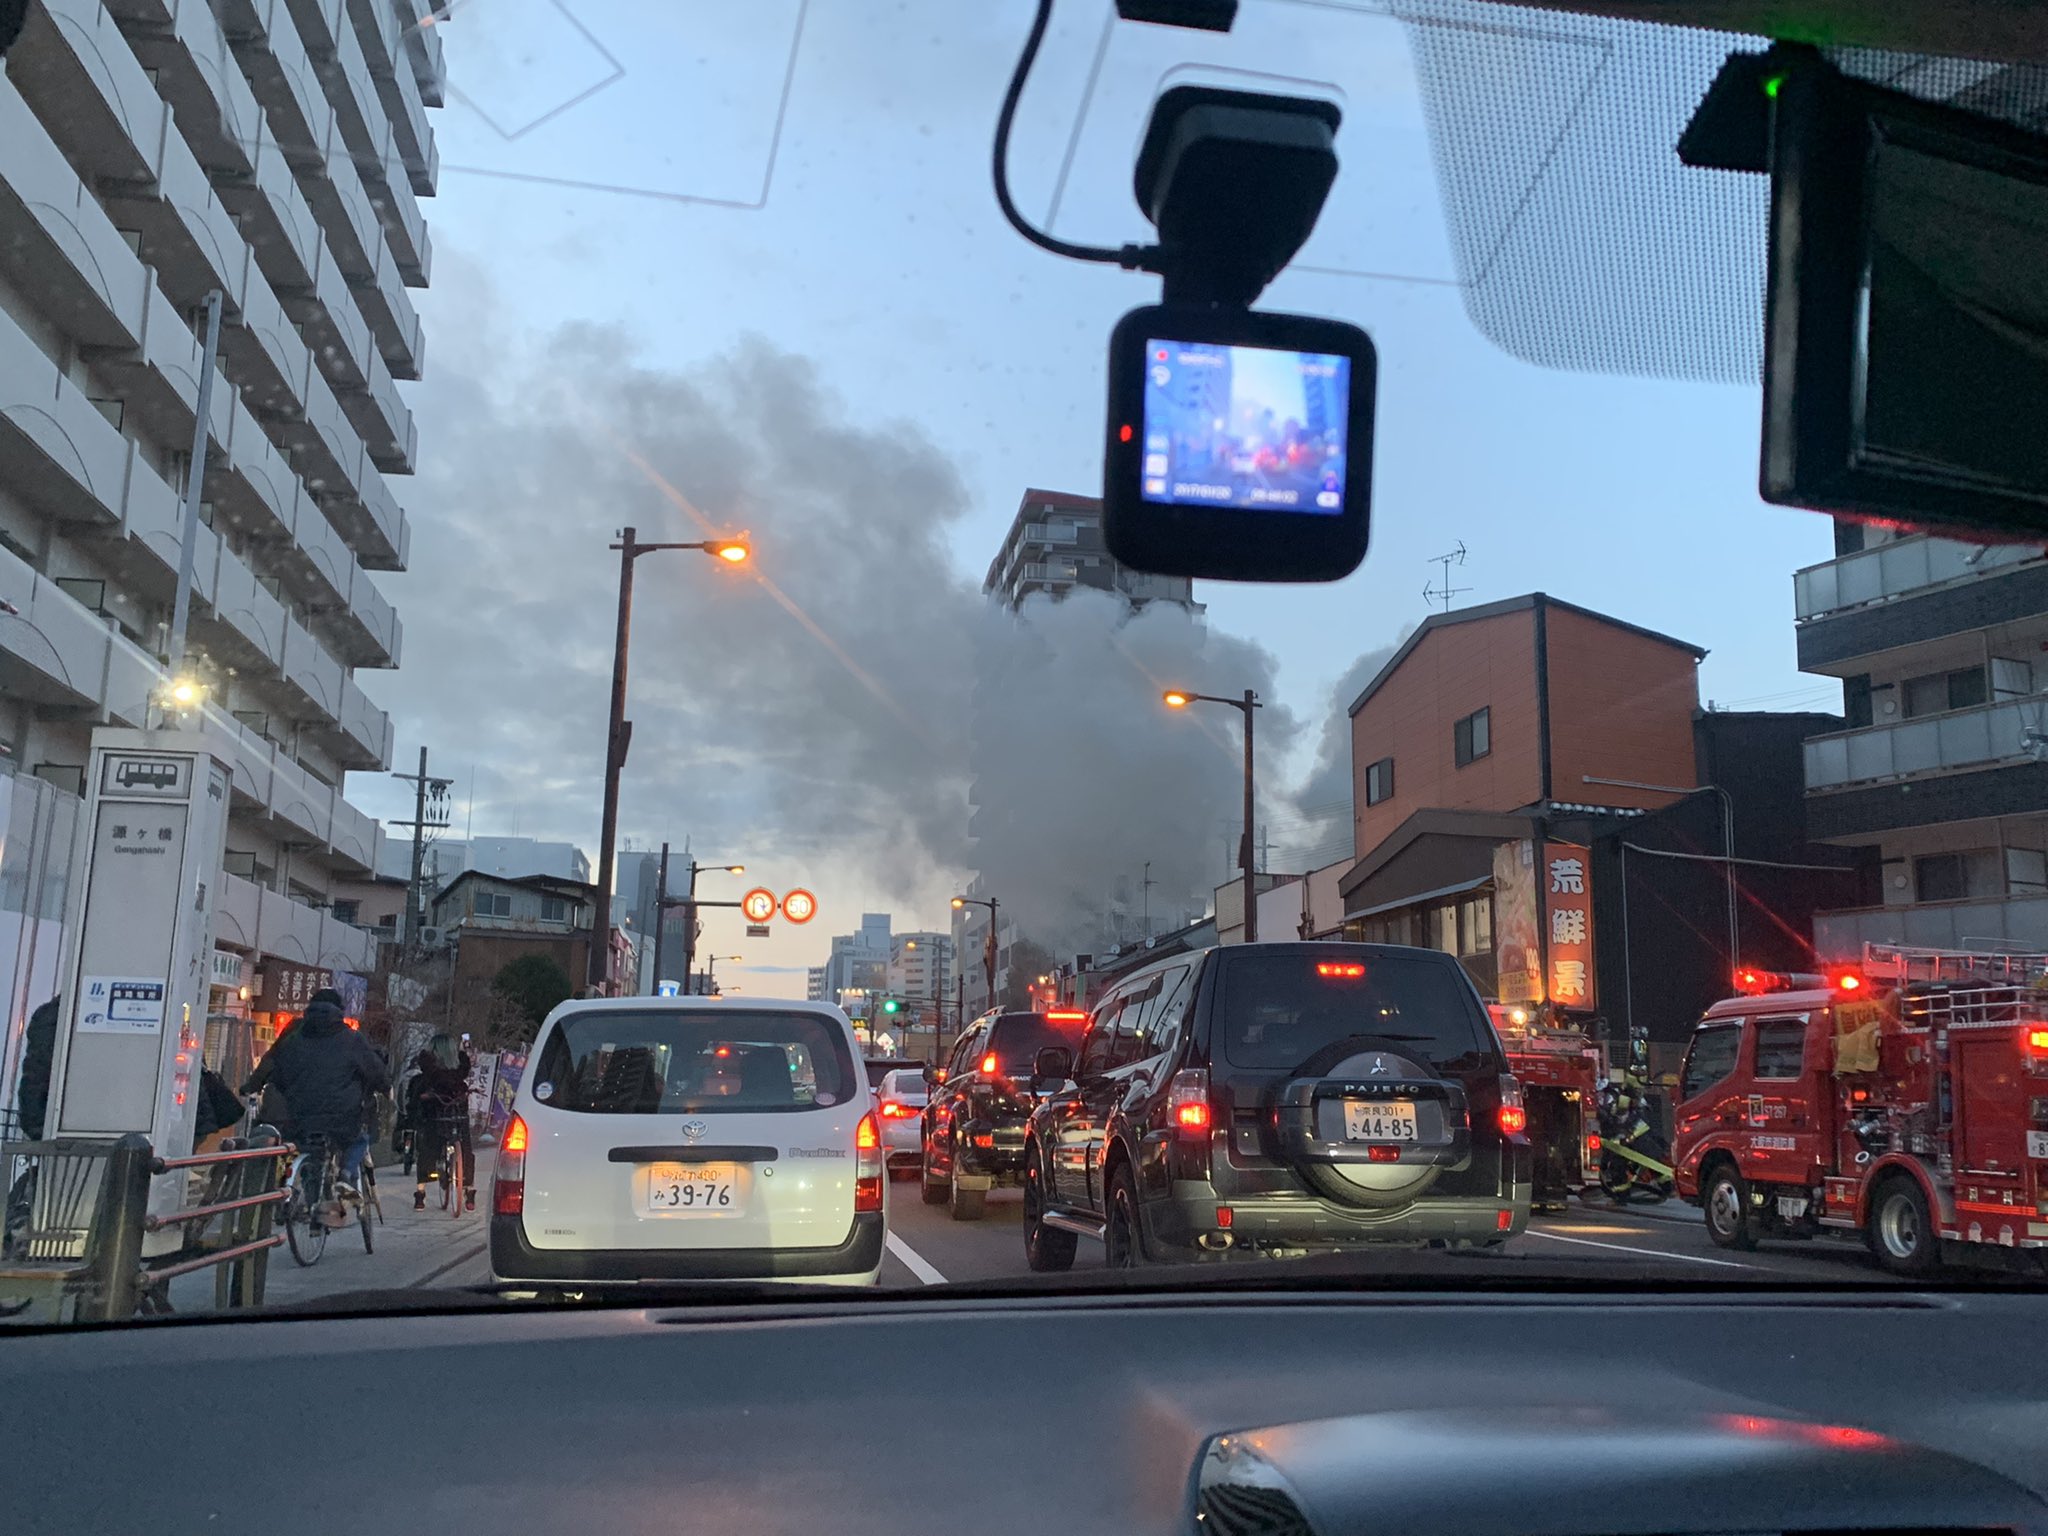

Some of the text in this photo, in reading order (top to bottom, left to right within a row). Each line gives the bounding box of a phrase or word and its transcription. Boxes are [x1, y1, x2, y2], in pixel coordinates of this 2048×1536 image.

[789, 899, 809, 914] 50
[1345, 1084, 1419, 1093] PAJERO
[1362, 1118, 1414, 1137] 44-85
[668, 1184, 730, 1206] 39-76
